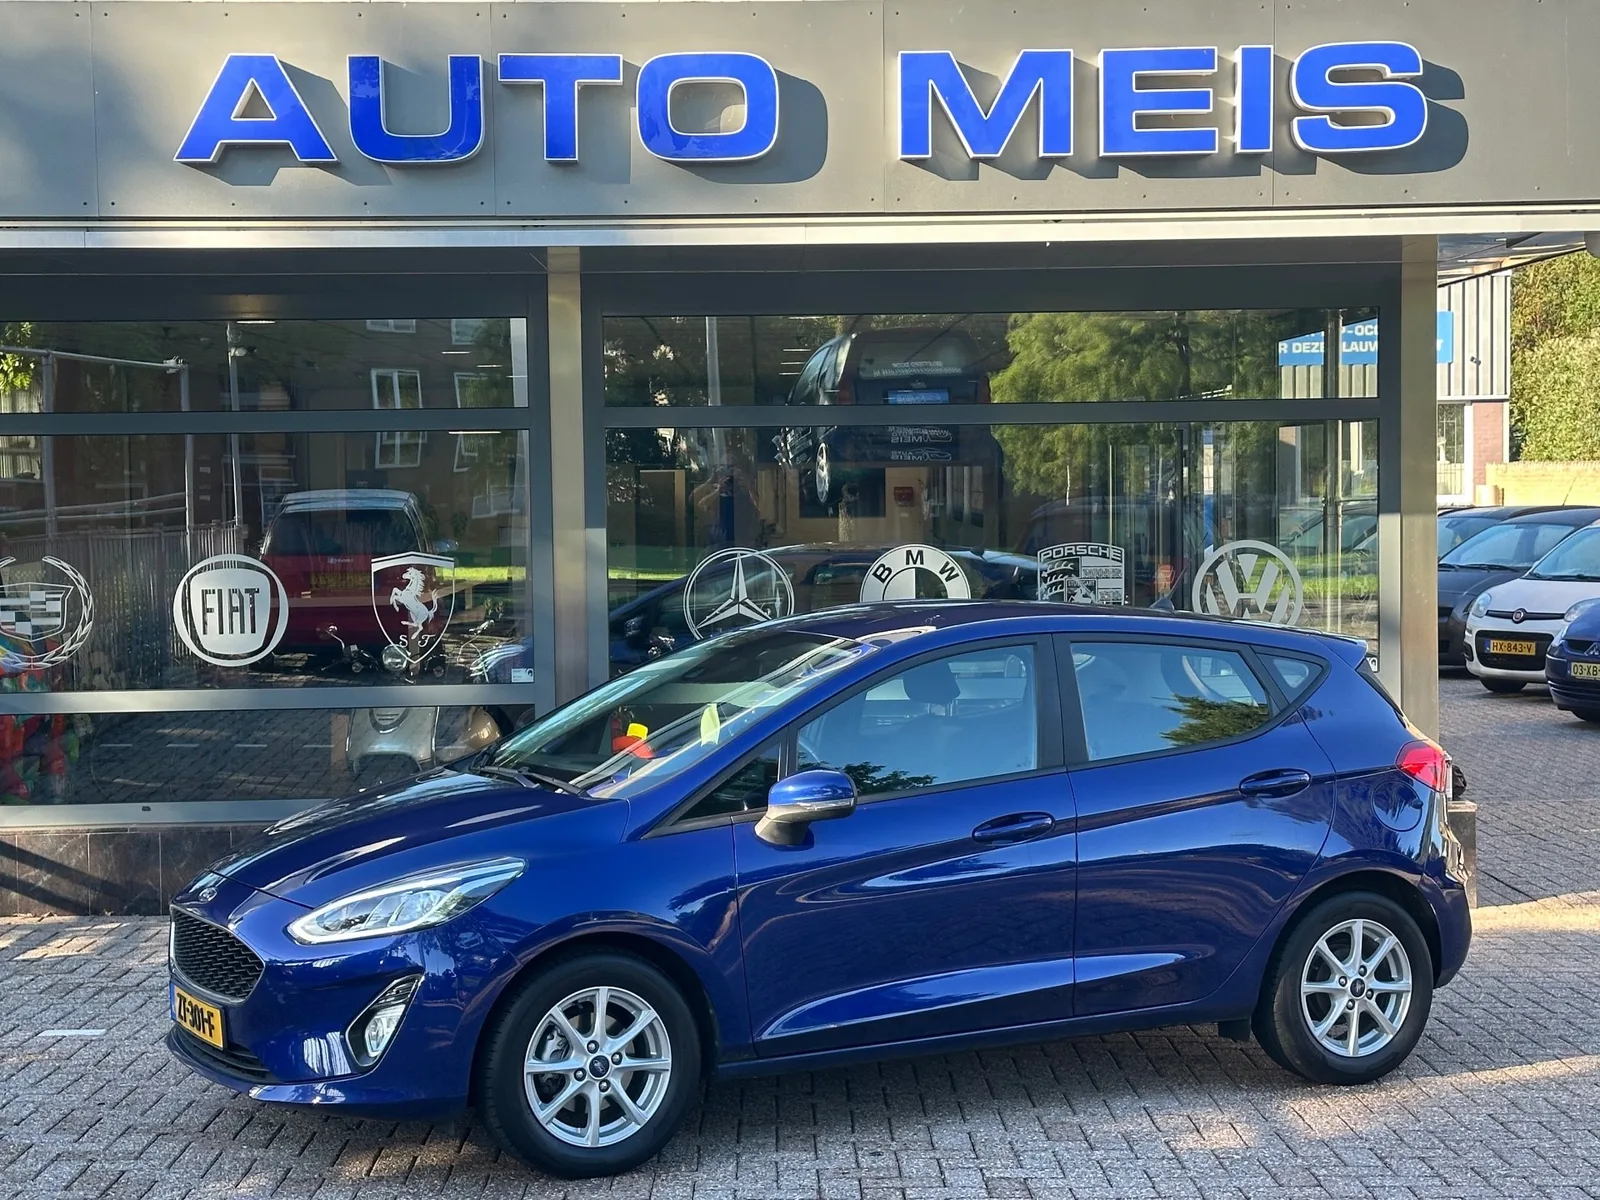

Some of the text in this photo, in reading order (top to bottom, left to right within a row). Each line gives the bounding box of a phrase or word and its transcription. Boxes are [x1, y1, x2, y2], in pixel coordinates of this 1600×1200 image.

[174, 40, 1428, 165] AUTO MEIS
[872, 549, 960, 584] BMW
[1040, 545, 1122, 563] PORSCHE
[201, 588, 260, 635] FIAT
[1492, 641, 1533, 653] HX-843-V
[176, 992, 215, 1039] ZT-301-F
